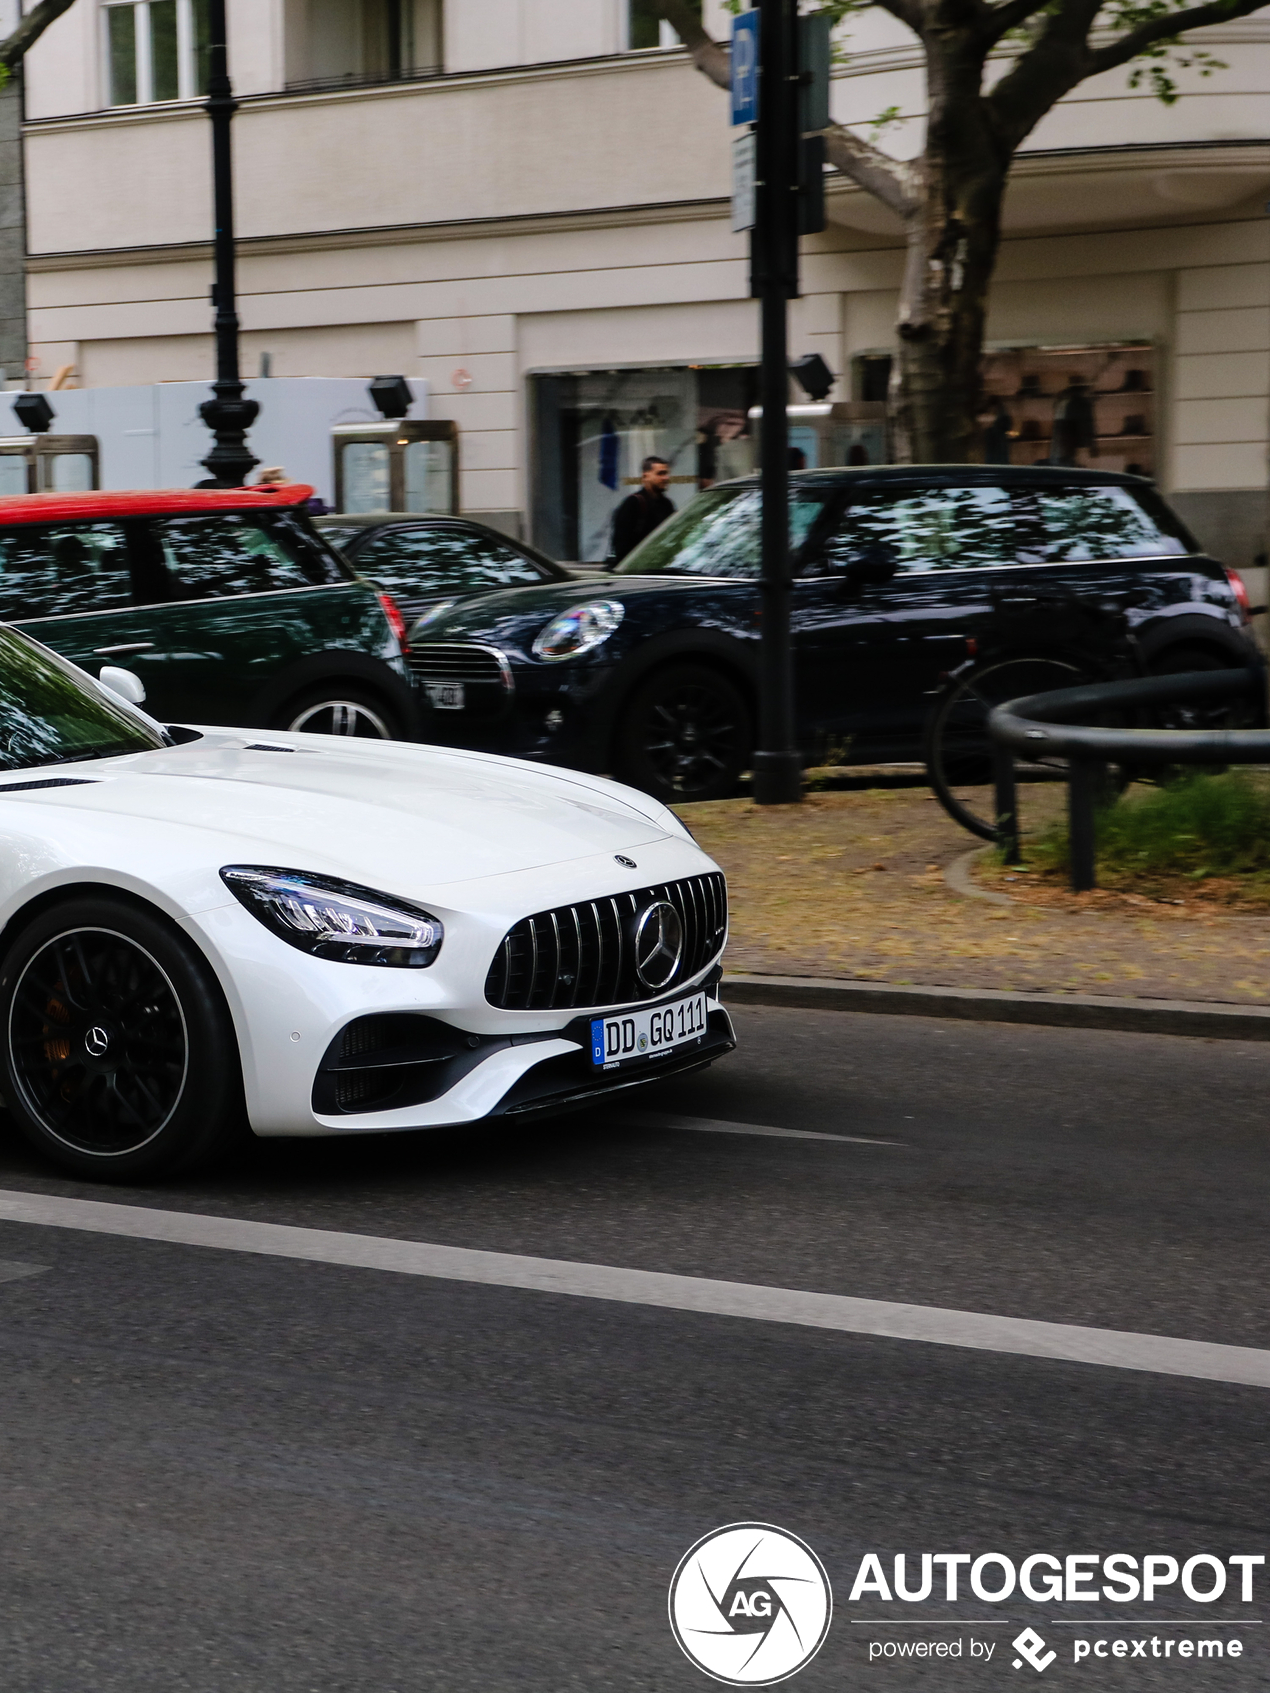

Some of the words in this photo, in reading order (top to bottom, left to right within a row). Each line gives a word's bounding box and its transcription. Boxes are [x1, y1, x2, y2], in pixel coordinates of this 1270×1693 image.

[606, 1018, 635, 1057] DD
[650, 1008, 674, 1046] GQ
[678, 997, 704, 1038] 111
[595, 1047, 601, 1057] D
